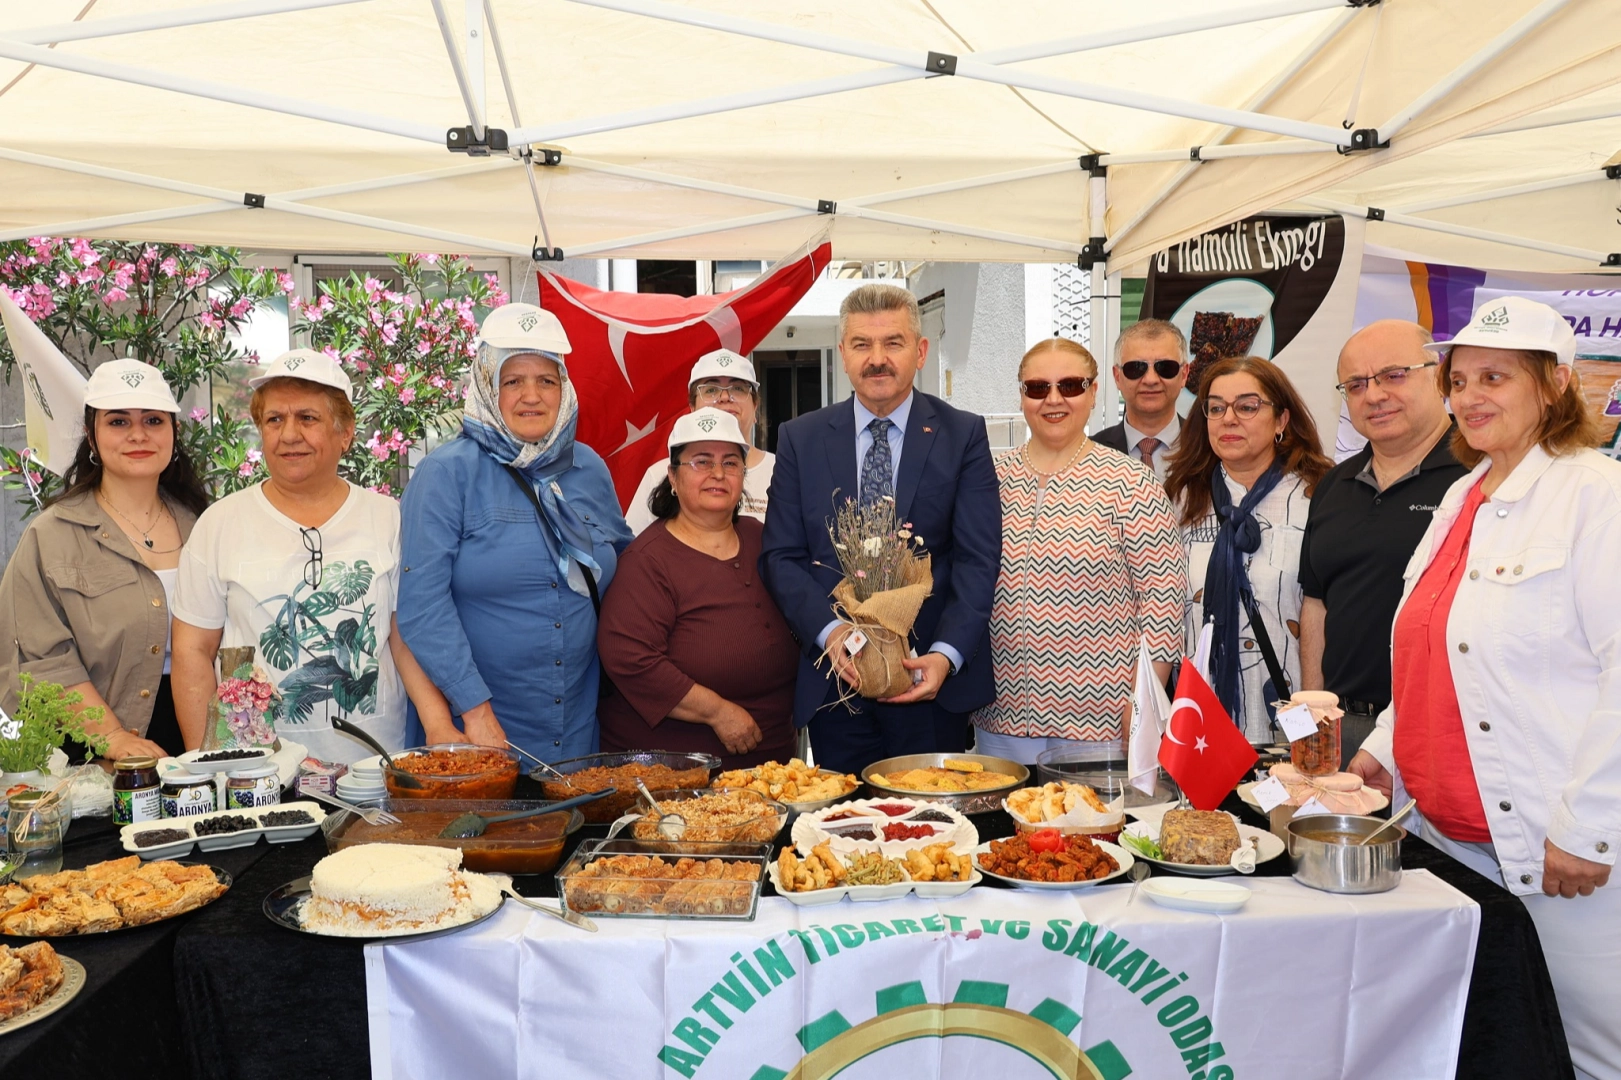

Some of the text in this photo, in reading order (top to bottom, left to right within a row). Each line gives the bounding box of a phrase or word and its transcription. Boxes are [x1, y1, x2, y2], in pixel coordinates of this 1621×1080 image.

[1598, 316, 1621, 338] H
[178, 802, 212, 817] ARONYA
[657, 939, 796, 1079] ARTVİN
[788, 913, 967, 965] TİCARET
[980, 919, 1031, 940] ve
[1041, 919, 1189, 1006] SANAYİ
